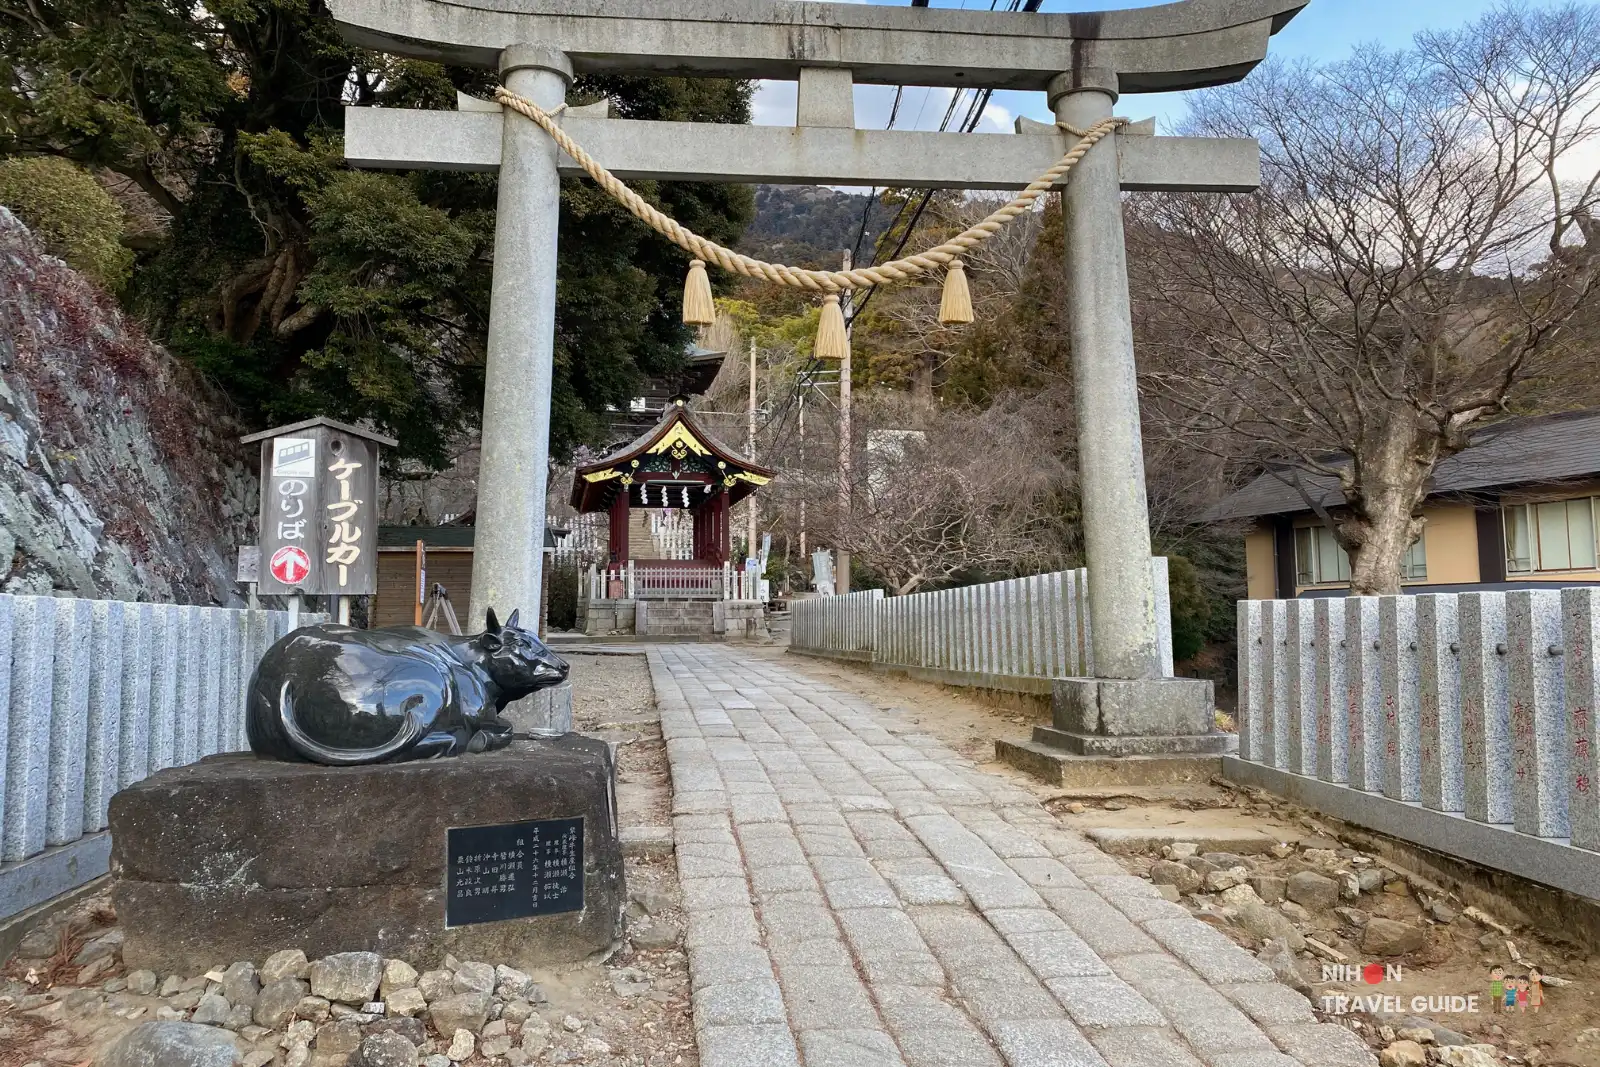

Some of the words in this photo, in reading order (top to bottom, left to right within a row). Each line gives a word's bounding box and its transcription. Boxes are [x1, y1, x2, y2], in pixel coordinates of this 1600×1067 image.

[277, 479, 308, 540] のりば
[325, 458, 363, 587] ケーブルカー
[516, 838, 525, 870] 組合員
